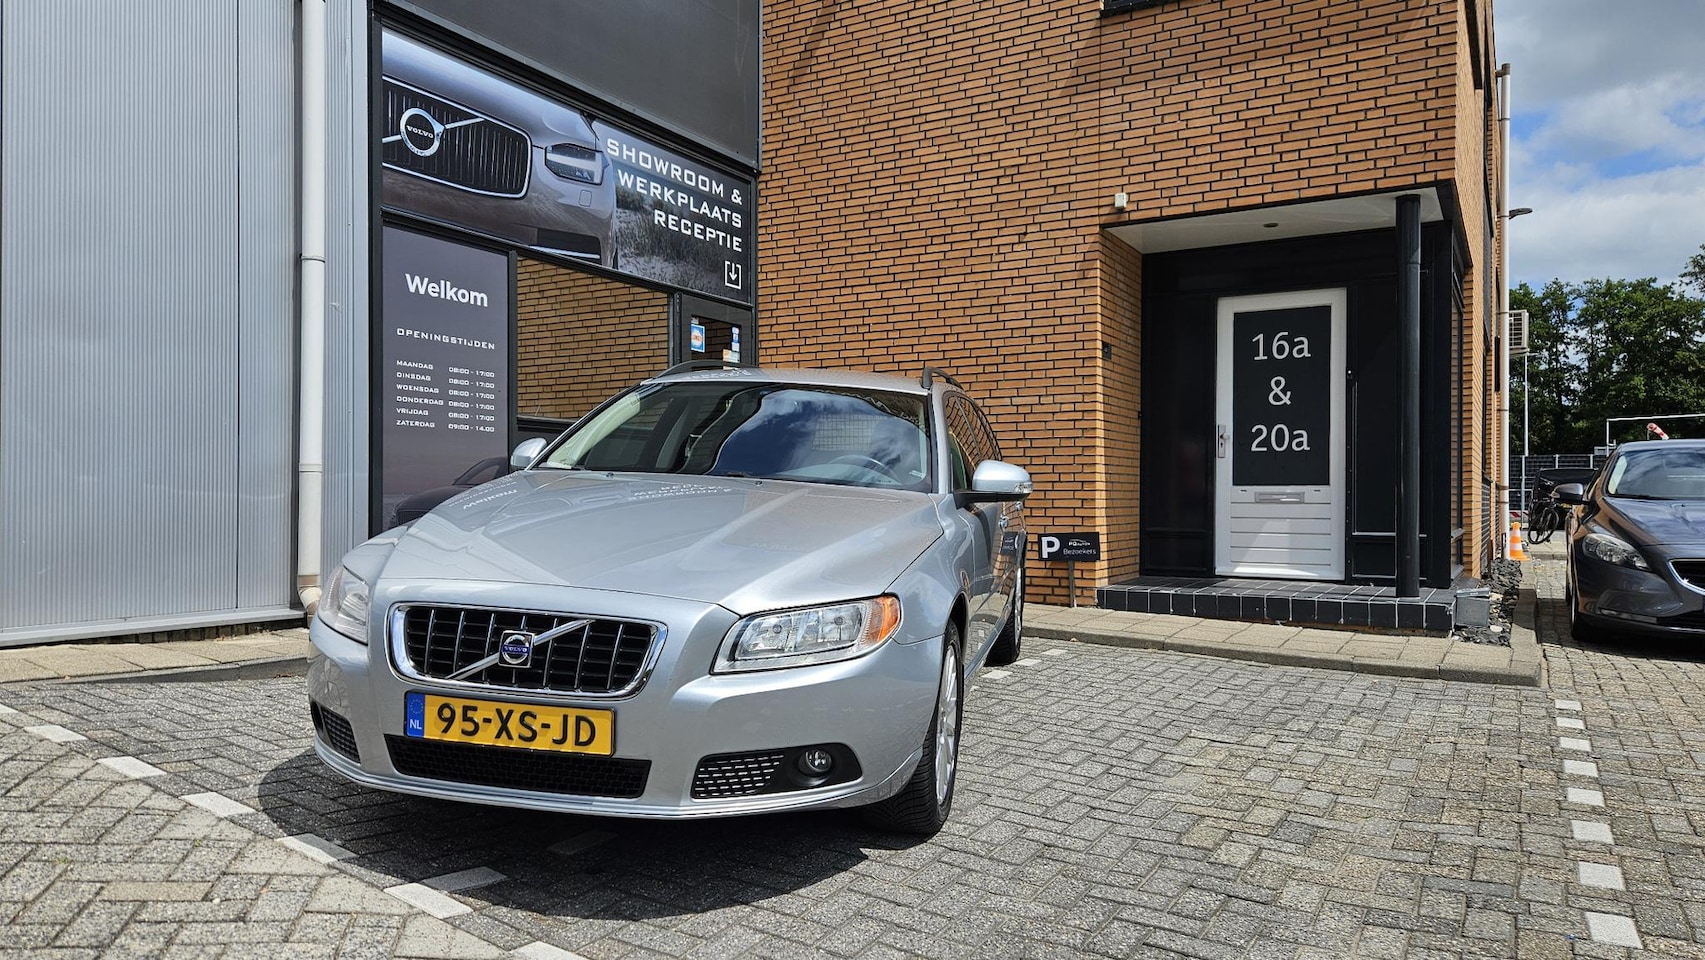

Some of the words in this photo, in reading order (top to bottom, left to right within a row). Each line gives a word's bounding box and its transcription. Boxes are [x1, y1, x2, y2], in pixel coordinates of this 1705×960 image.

[406, 125, 434, 139] VOLVO
[607, 138, 724, 198] SHOWROOM
[731, 188, 742, 205] &
[617, 169, 742, 228] WERKPLAATS
[654, 209, 742, 252] RECEPTIE
[405, 273, 488, 307] Welkom
[396, 328, 495, 350] OPENINGSTIJDEN
[1252, 331, 1312, 360] 16a
[396, 360, 434, 370] MAANDAG
[396, 372, 431, 381] DINSDAG
[396, 384, 439, 393] WOENSDAG
[1268, 376, 1292, 406] &
[396, 396, 444, 406] DONDERDAG
[396, 408, 429, 416] VRIJDAG
[1251, 423, 1311, 452] 20a
[1041, 536, 1060, 558] P
[409, 718, 423, 730] NL
[437, 702, 596, 747] 95-XS-JD
